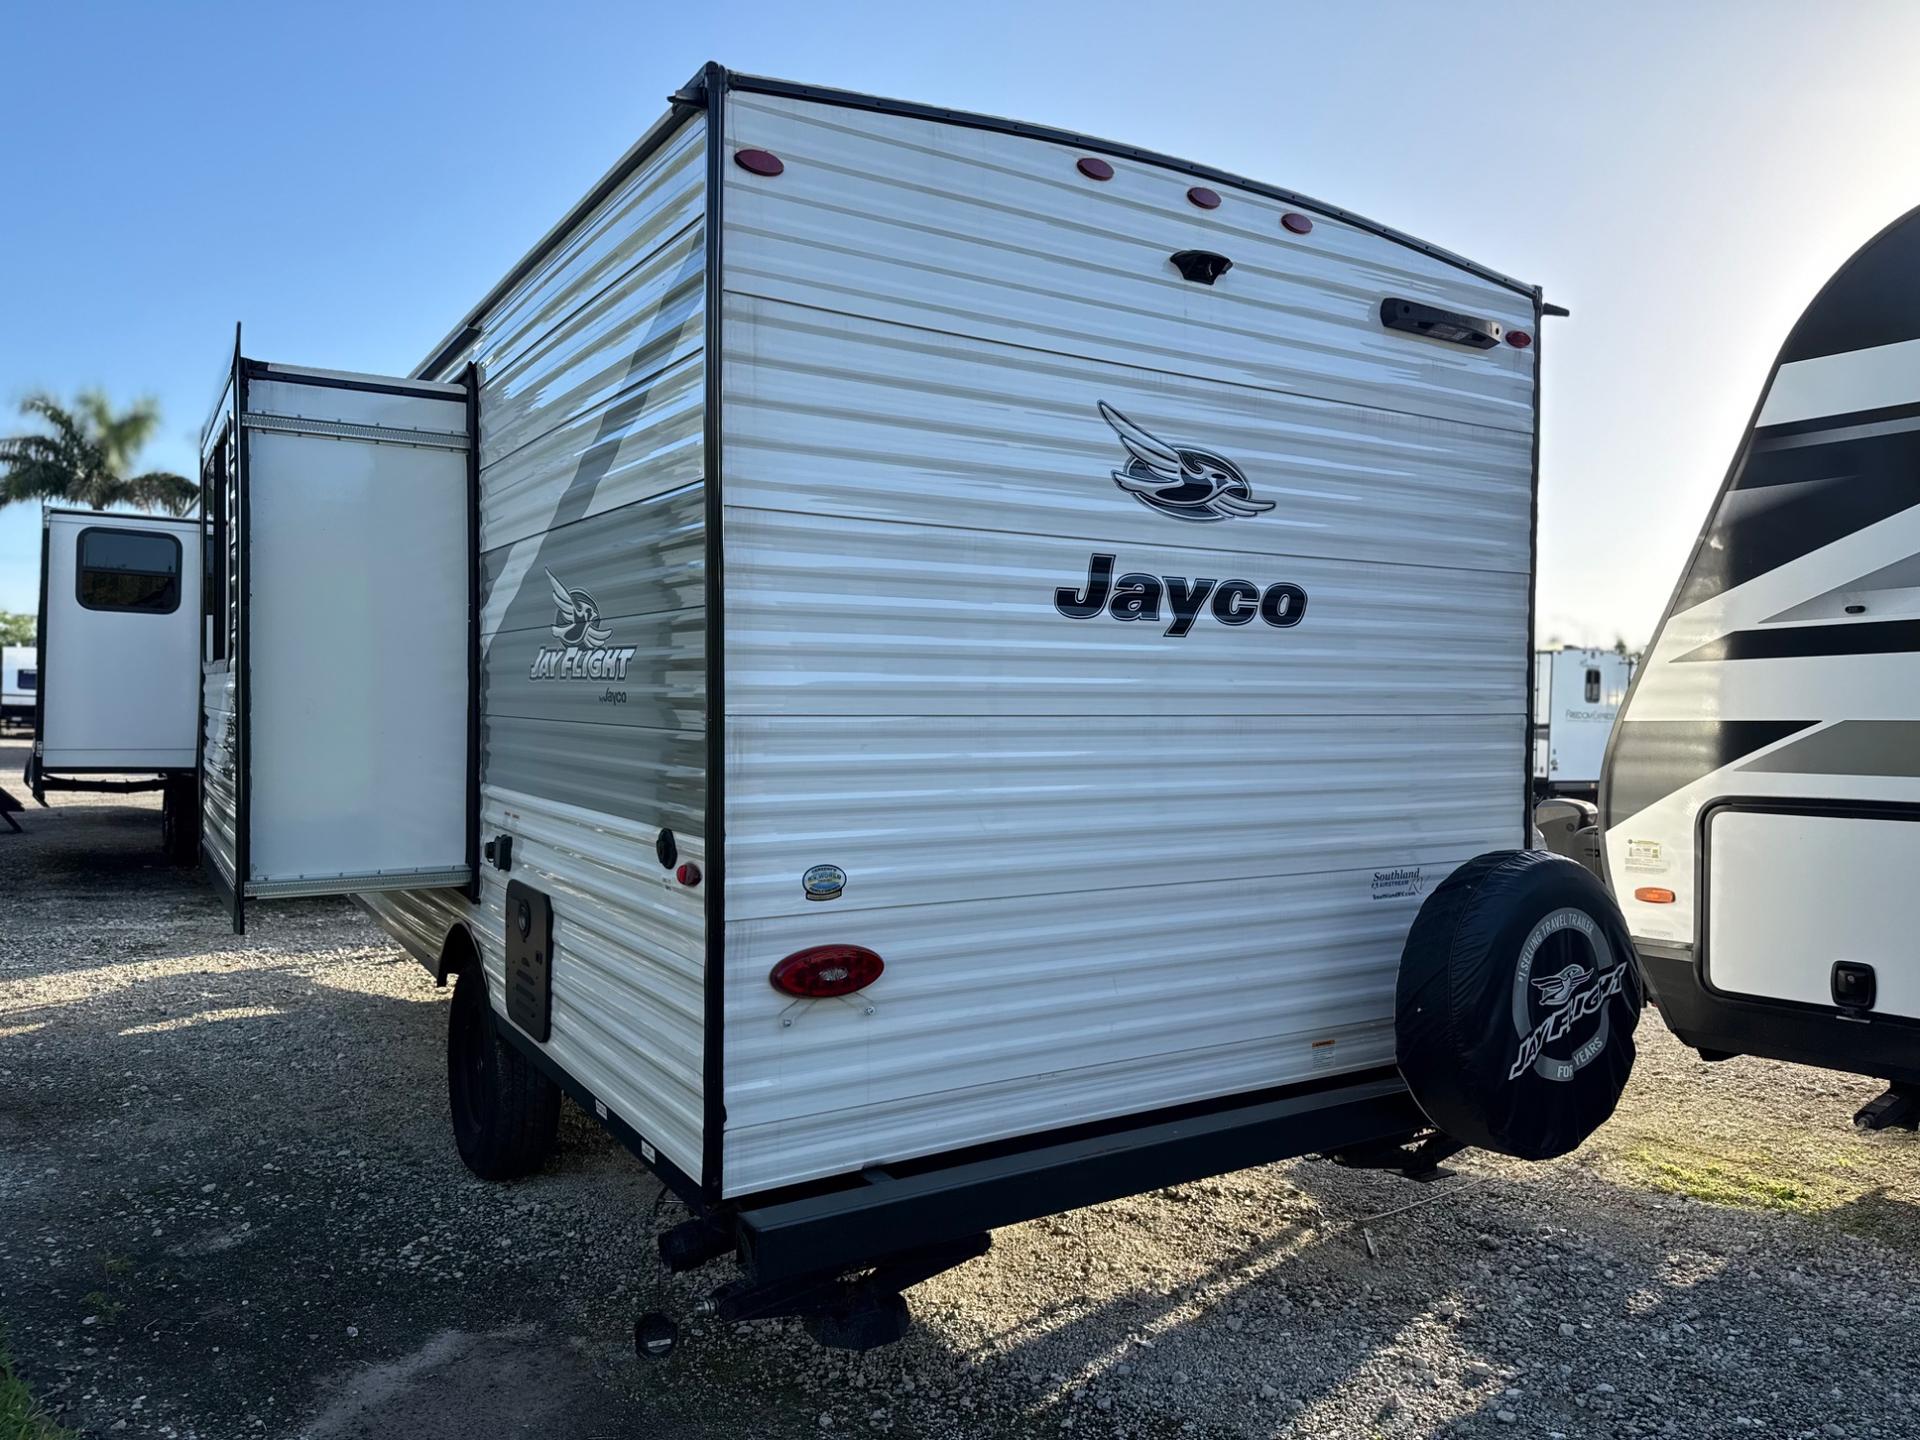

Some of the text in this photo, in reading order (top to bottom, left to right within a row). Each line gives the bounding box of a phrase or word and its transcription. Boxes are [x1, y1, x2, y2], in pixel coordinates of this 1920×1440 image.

[1054, 553, 1308, 637] Jayco
[530, 645, 638, 680] JAY FLIGHT
[603, 686, 627, 706] Jayco
[1373, 867, 1420, 882] Southland
[1520, 931, 1543, 971] SELLING
[1541, 914, 1568, 936] TRAVEL
[1568, 913, 1595, 935] TRAILER
[1508, 961, 1628, 1080] JAY FIGHT
[1557, 1037, 1603, 1078] FOR YEARS
